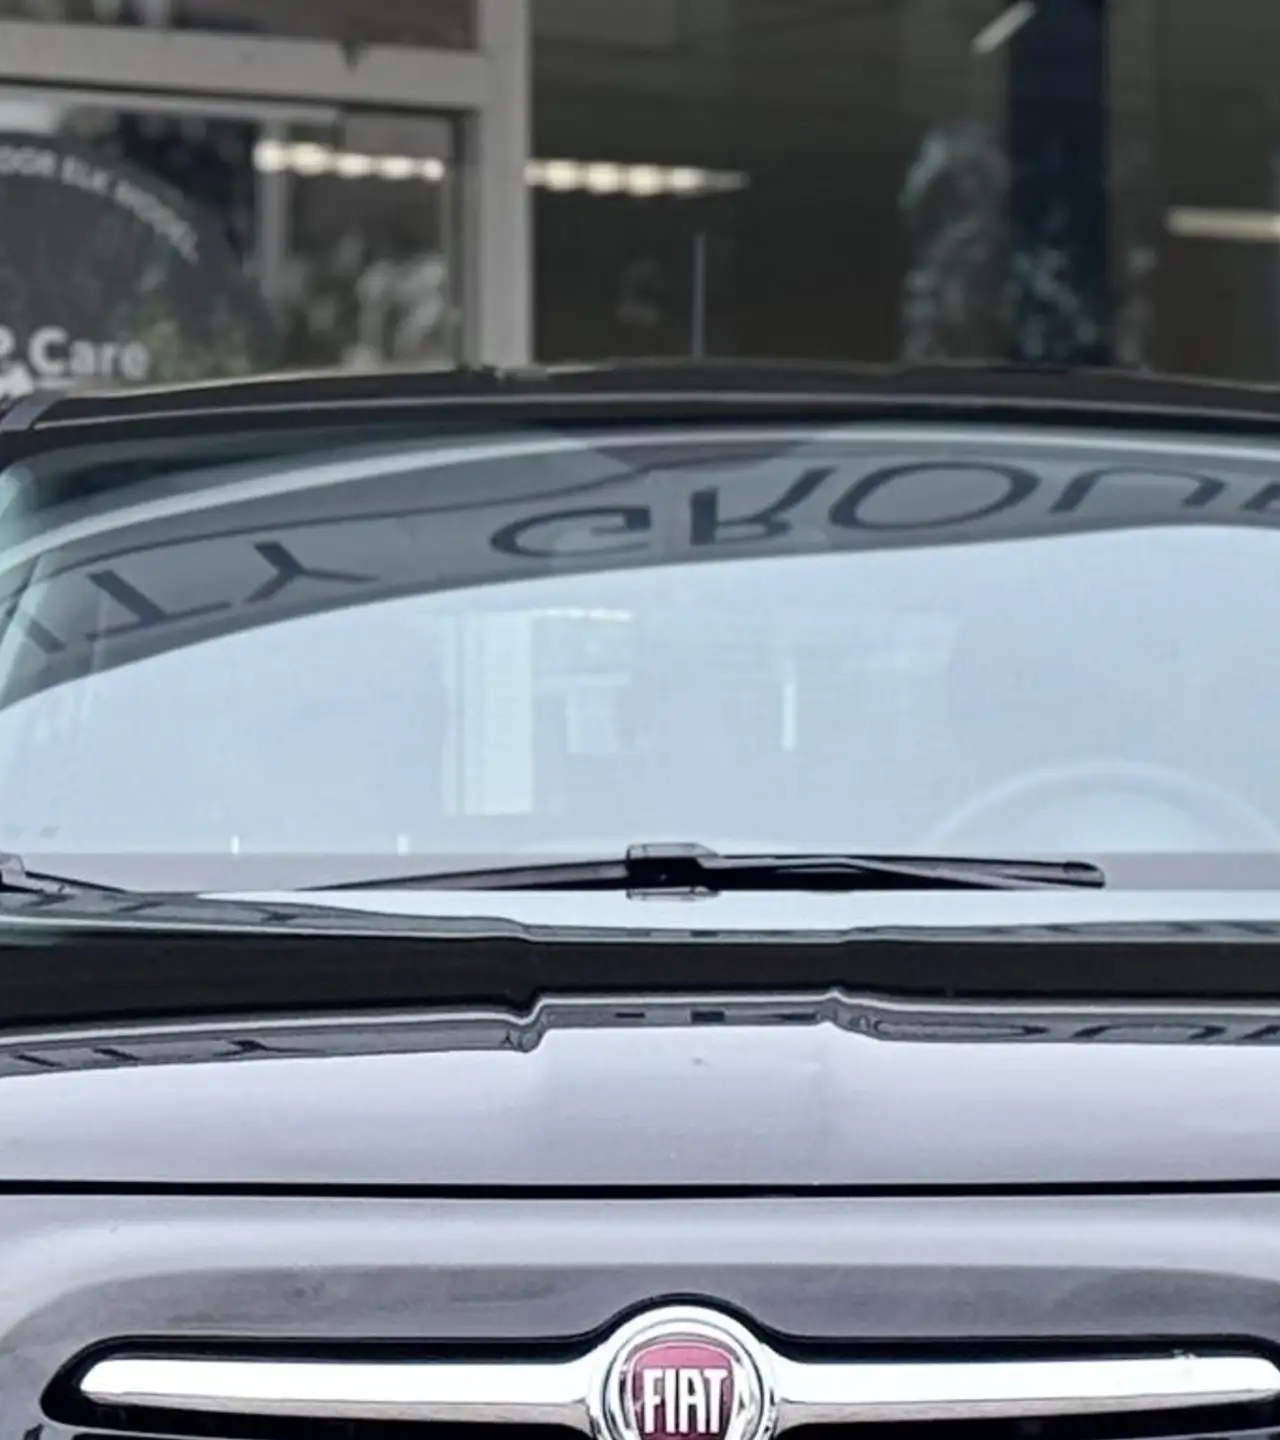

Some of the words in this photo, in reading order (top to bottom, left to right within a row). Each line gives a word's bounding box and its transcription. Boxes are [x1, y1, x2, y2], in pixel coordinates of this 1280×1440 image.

[61, 154, 113, 195] ELK
[28, 325, 151, 381] Care
[643, 1367, 729, 1435] FIAT
